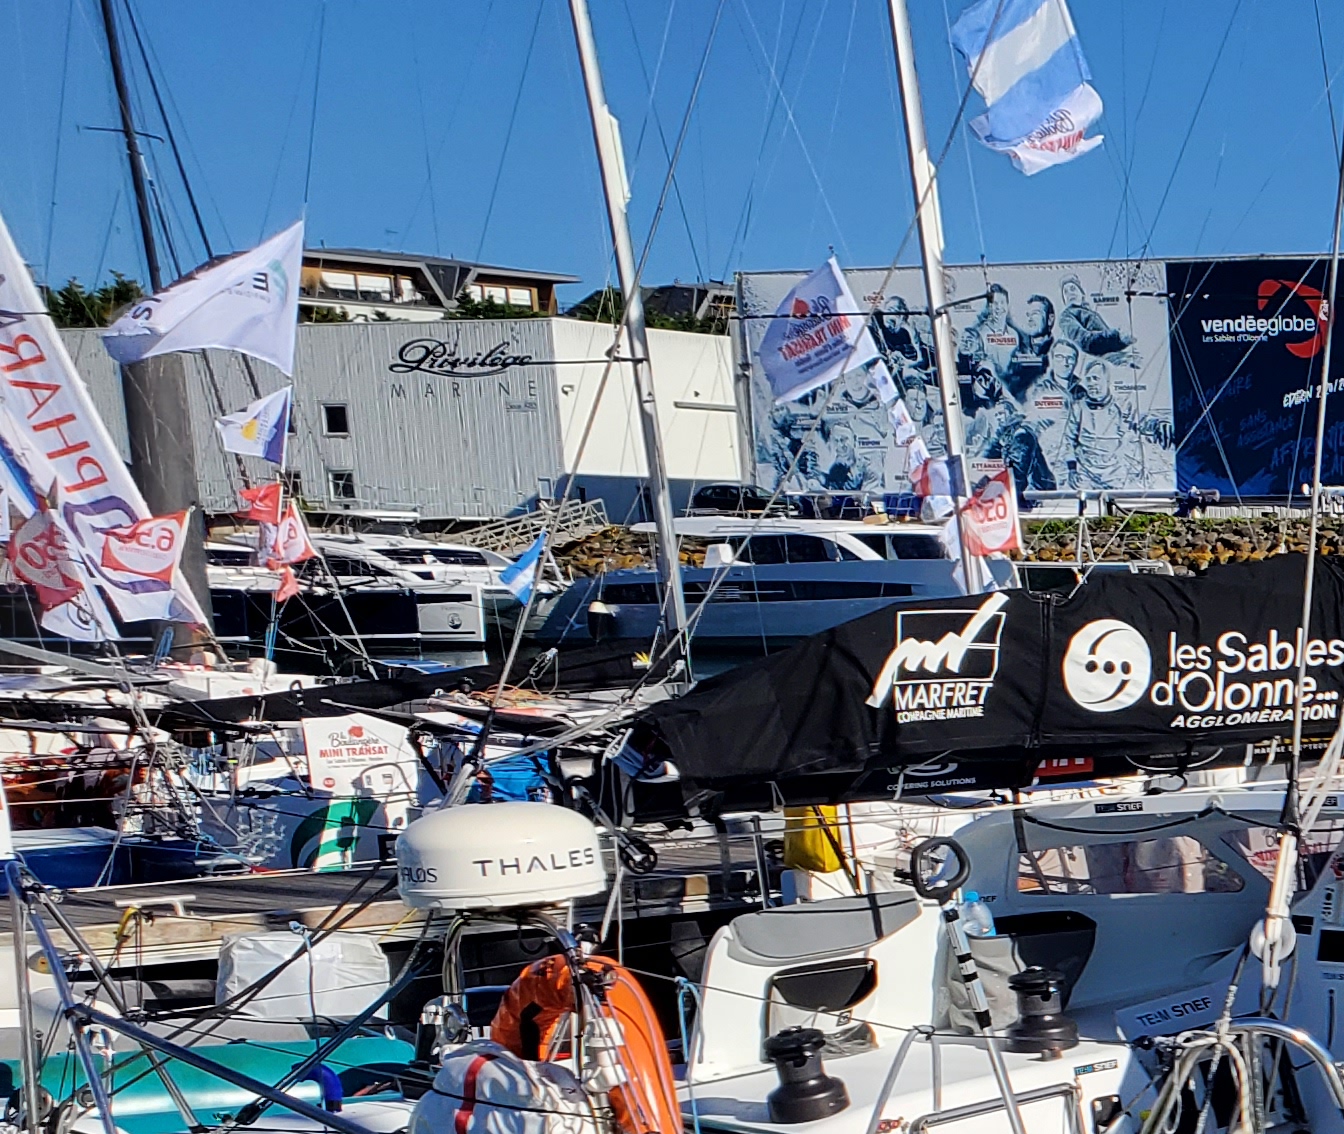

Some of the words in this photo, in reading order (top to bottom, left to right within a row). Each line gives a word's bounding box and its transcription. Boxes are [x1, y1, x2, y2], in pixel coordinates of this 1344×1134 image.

[391, 380, 537, 399] MARINE
[1168, 631, 1211, 670] les
[894, 683, 994, 710] MARFRET
[897, 709, 946, 724] COMPAGNIE
[946, 706, 984, 719] MARITIME
[320, 749, 343, 758] MINI
[346, 746, 388, 756] TRANSAT
[931, 777, 977, 788] SOLUTIONS
[472, 848, 594, 877] THALES
[1136, 1008, 1171, 1026] TEAM
